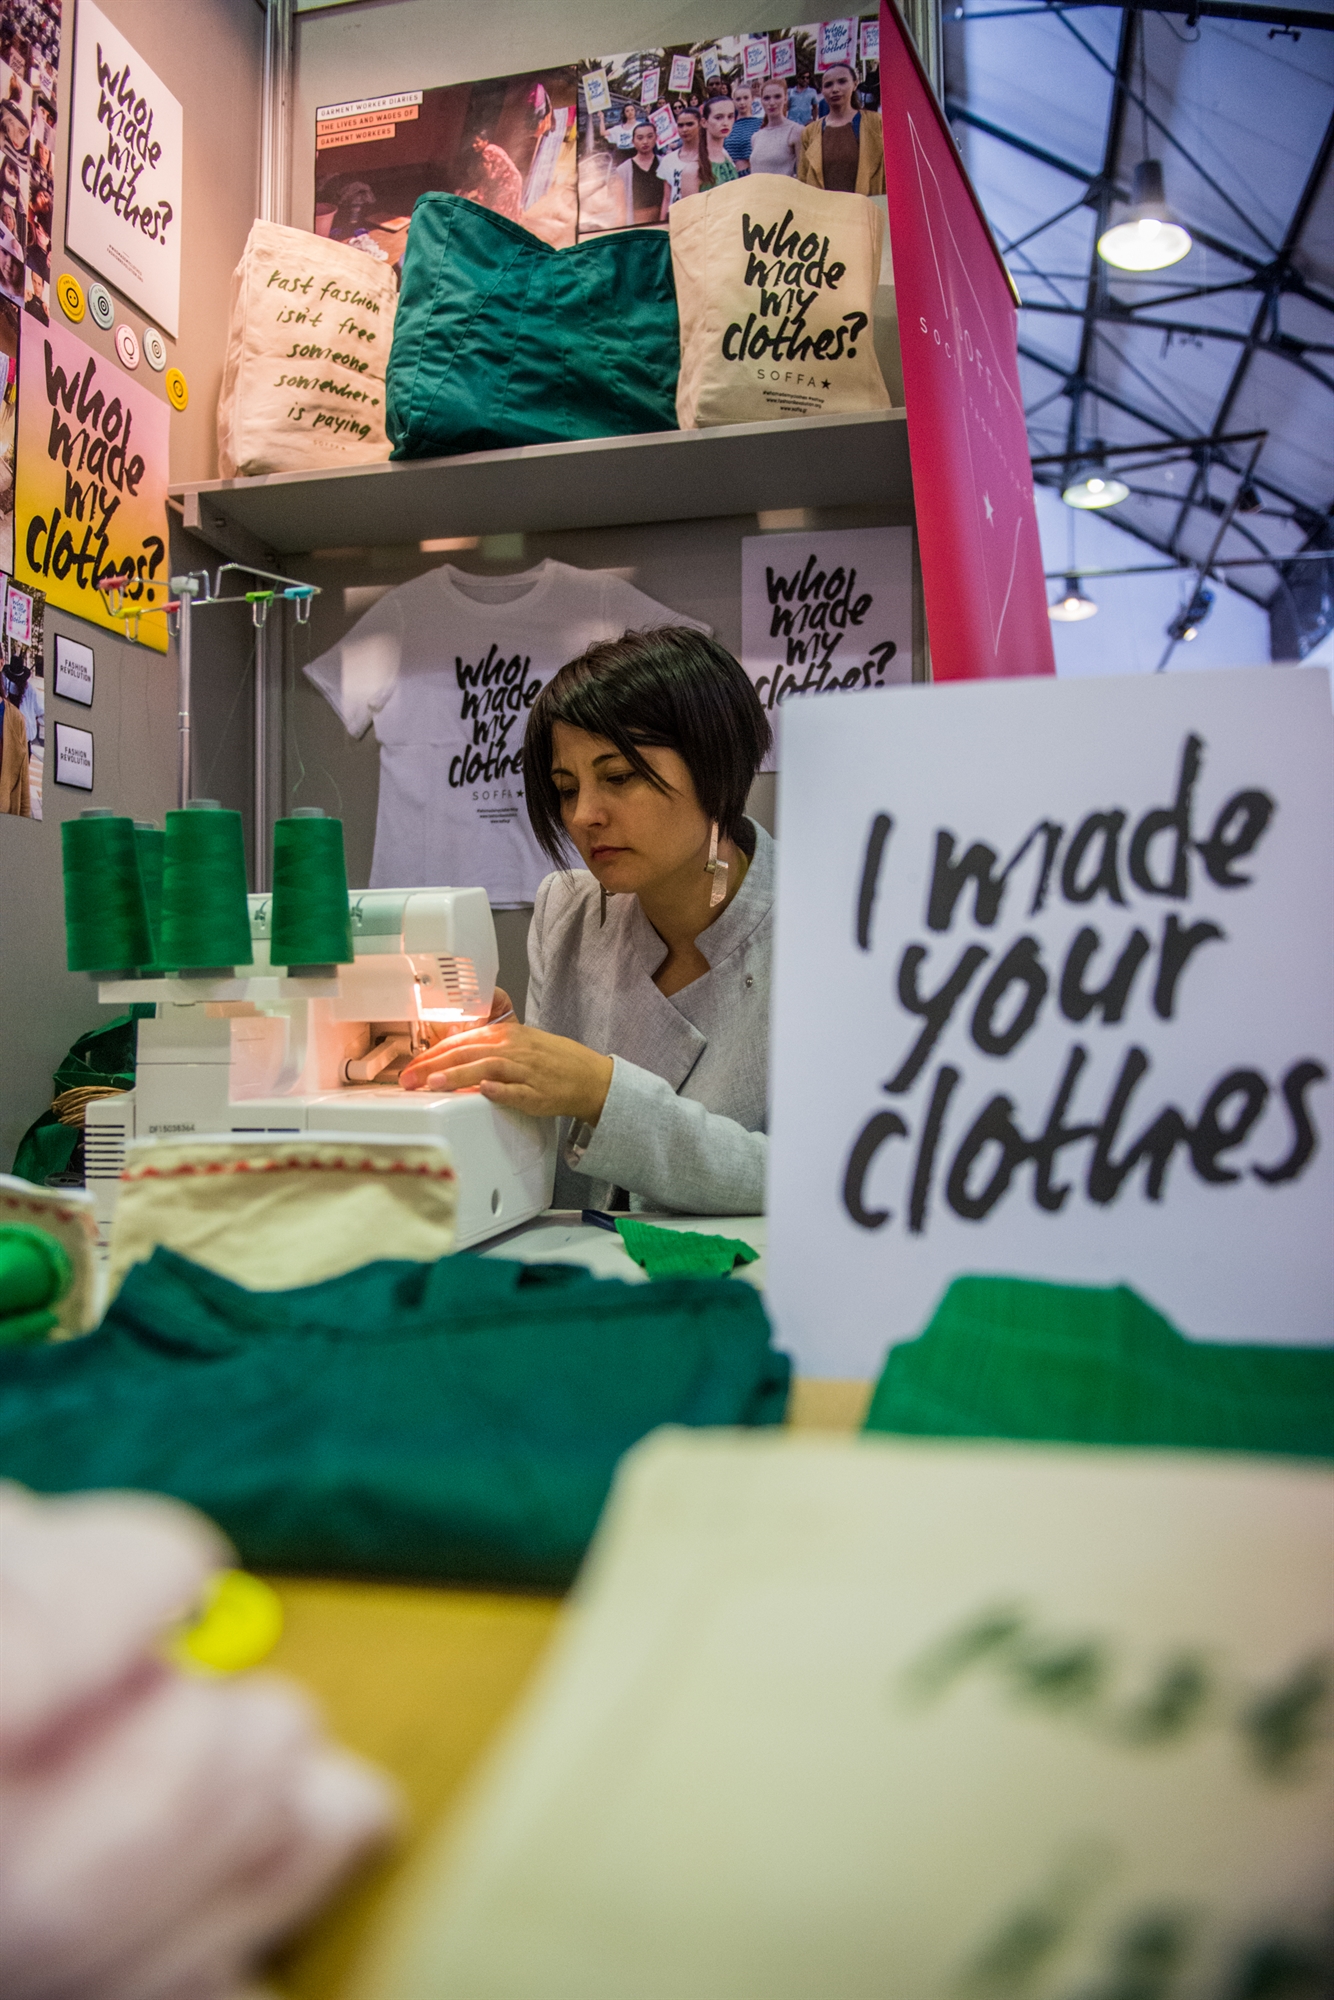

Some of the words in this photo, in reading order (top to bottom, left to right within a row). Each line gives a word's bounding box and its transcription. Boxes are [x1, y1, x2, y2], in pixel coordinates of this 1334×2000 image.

[97, 42, 147, 126] who
[321, 106, 354, 116] GARMENT
[356, 100, 386, 110] WORKER
[389, 95, 418, 105] DIARIES
[97, 88, 162, 169] made
[320, 134, 353, 145] GARMENT
[356, 128, 391, 139] WORKERS
[321, 123, 334, 131] THE
[337, 118, 357, 128] LIVES
[360, 115, 374, 124] AND
[376, 111, 402, 121] WAGES
[404, 109, 414, 117] OF
[108, 132, 144, 188] my
[81, 153, 173, 245] clothes?
[742, 209, 820, 262] who
[744, 236, 846, 290] made
[320, 281, 380, 315] fashion
[760, 288, 819, 325] my
[277, 306, 322, 327] isn't
[339, 318, 376, 343] free
[722, 311, 868, 361] clothes?
[286, 343, 369, 373] someone
[757, 369, 816, 387] SOFFA
[44, 338, 123, 443] who
[274, 375, 380, 406] somewhere
[288, 402, 305, 421] is
[312, 412, 371, 441] paying
[48, 407, 145, 497] made
[64, 470, 121, 540] my
[26, 507, 165, 602] clothes?
[766, 554, 846, 604] who
[769, 568, 873, 637] made
[60, 664, 91, 683] REVOLUTION
[64, 658, 88, 674] FASHION
[455, 643, 522, 690] who
[786, 631, 844, 669] my
[460, 656, 543, 720] made
[64, 746, 87, 759] FASHION
[473, 714, 518, 748] my
[60, 752, 91, 767] REVOLUTION
[449, 740, 524, 788] clothe
[856, 810, 894, 952] I
[926, 730, 1275, 933] made
[884, 912, 1227, 1096] your
[841, 1039, 1327, 1238] clothes
